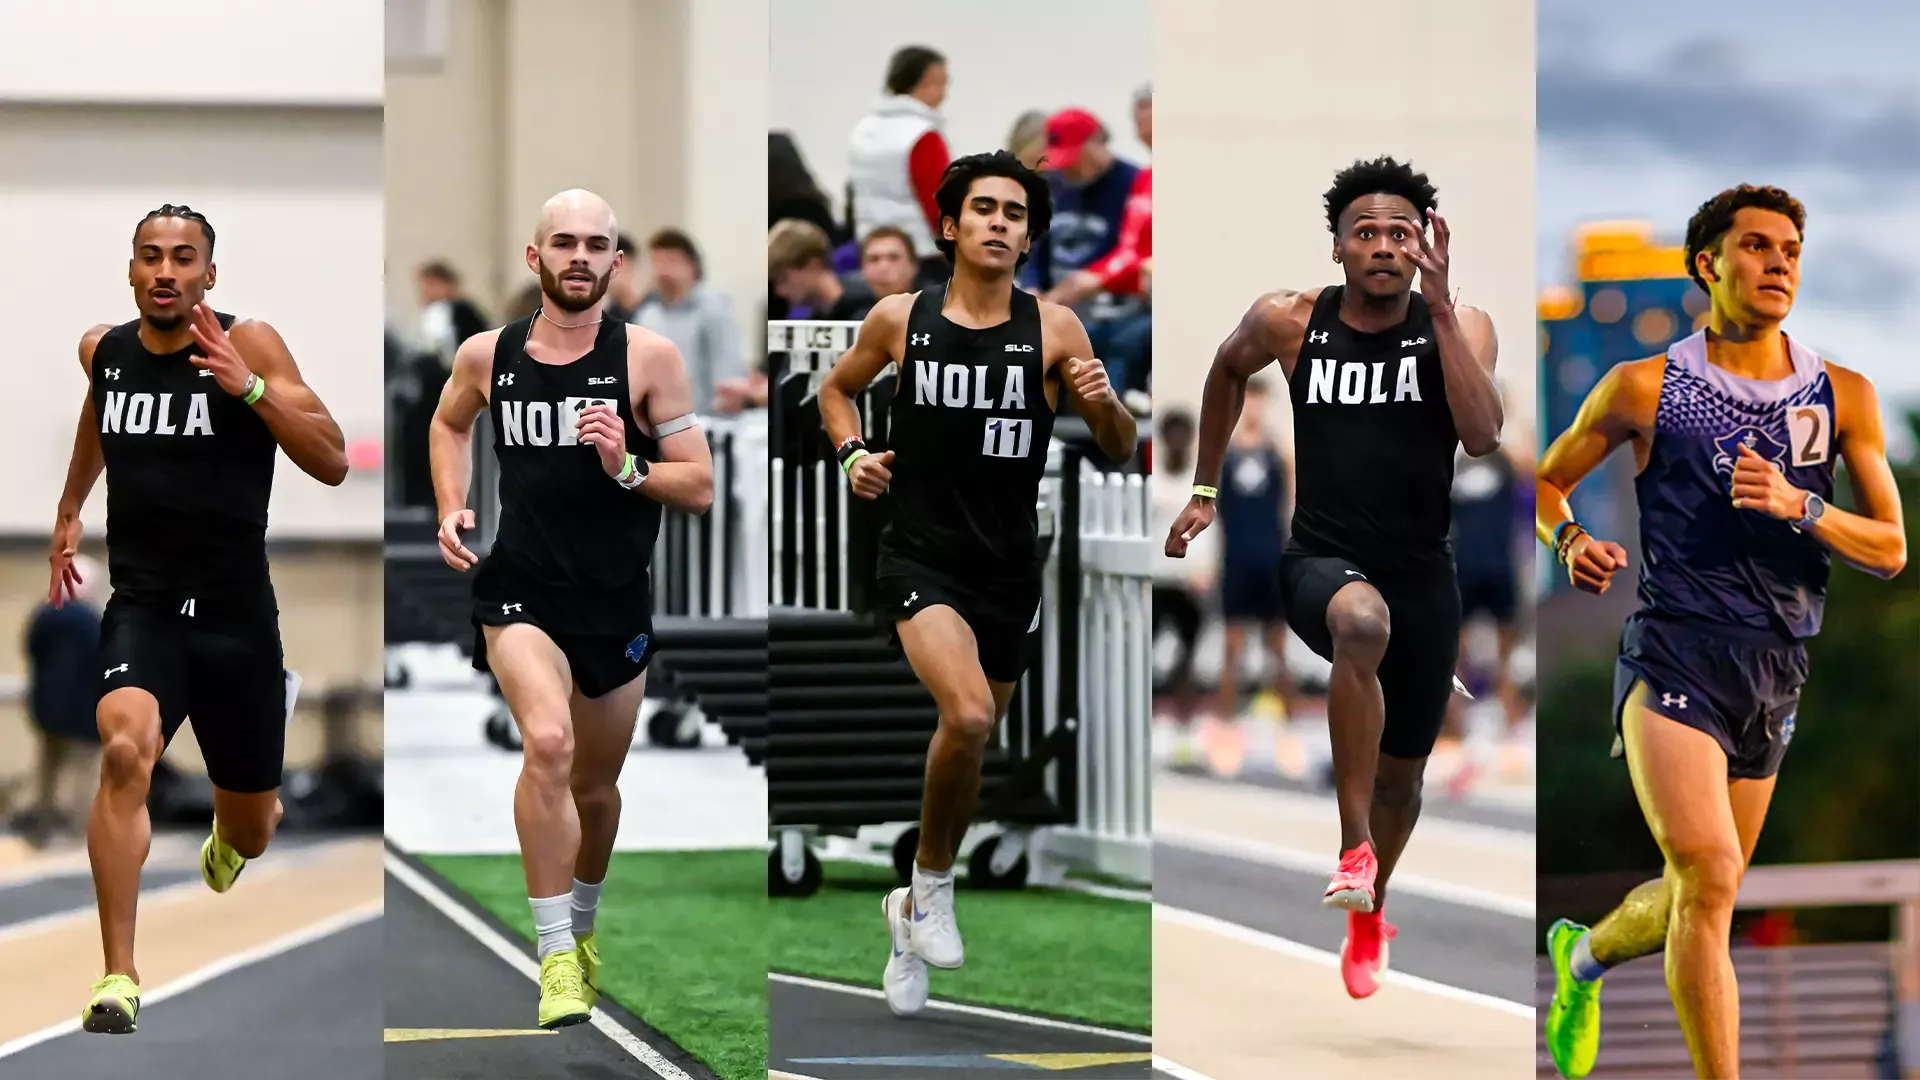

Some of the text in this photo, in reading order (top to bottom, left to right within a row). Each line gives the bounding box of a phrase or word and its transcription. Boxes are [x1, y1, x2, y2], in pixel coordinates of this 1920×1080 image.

[915, 360, 1026, 410] NOLA
[1306, 356, 1422, 405] NOLA
[102, 391, 214, 436] NOLA
[988, 420, 1022, 456] 11
[1796, 408, 1822, 462] 2
